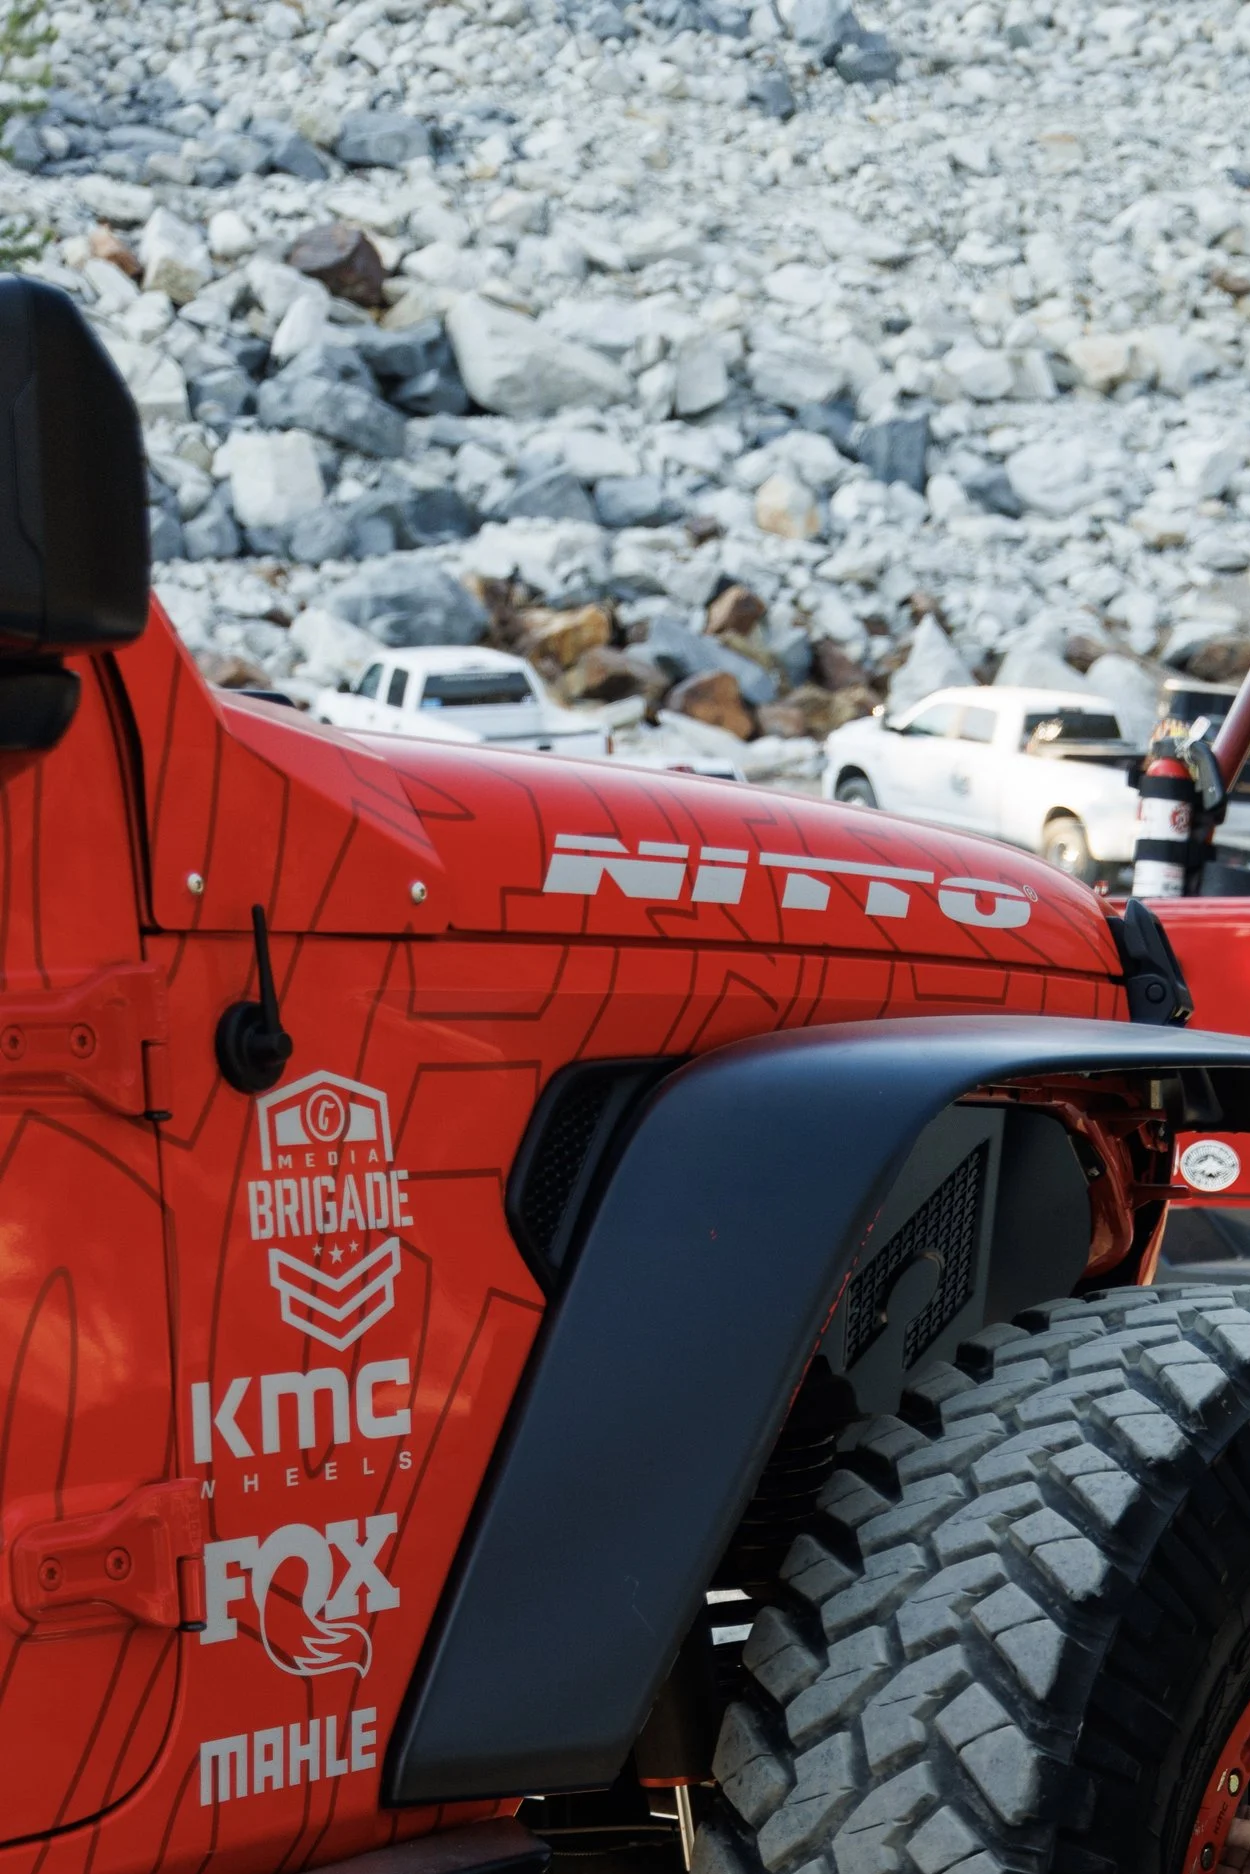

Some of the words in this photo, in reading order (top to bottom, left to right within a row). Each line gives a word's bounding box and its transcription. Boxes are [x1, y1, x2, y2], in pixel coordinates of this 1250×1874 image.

[542, 833, 1031, 929] NITTO
[247, 1169, 414, 1240] BRIGADE
[277, 1148, 379, 1170] MEDIA
[190, 1358, 412, 1465] KMC
[200, 1512, 400, 1678] FOX
[200, 1706, 377, 1807] MAHLE
